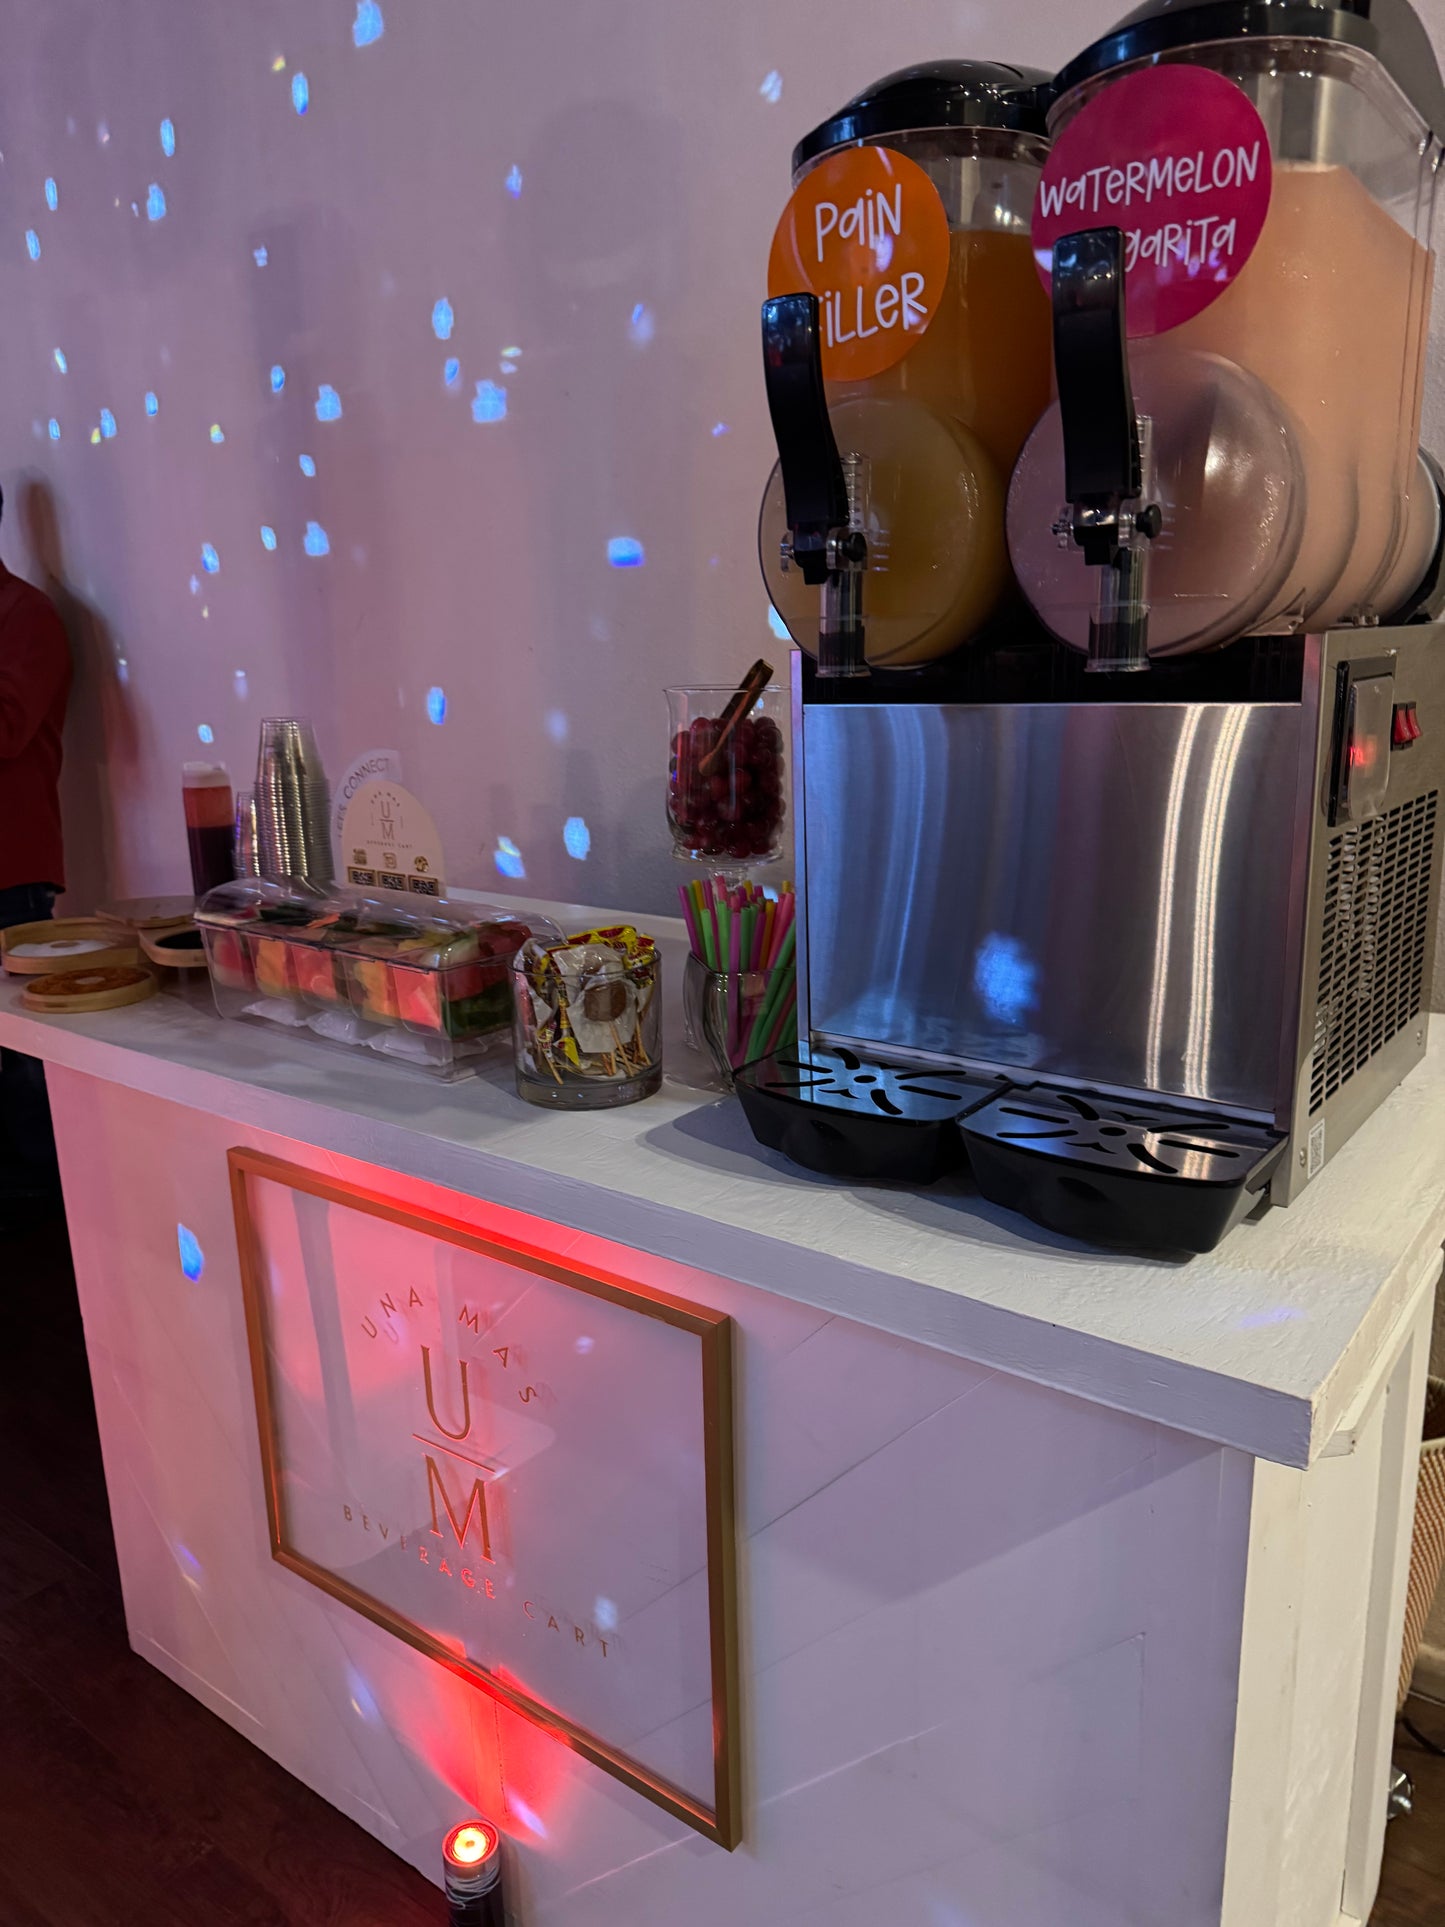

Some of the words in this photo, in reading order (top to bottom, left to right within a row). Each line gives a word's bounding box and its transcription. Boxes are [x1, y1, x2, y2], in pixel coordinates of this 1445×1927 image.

[820, 271, 928, 348] iLLeR
[343, 757, 390, 800] CONNECT
[361, 1286, 424, 1339] UNA
[458, 1305, 537, 1403] MAS
[421, 1344, 472, 1441] U
[422, 1452, 496, 1564] M
[343, 1505, 497, 1600] BEVERAGE
[523, 1601, 610, 1658] CART
